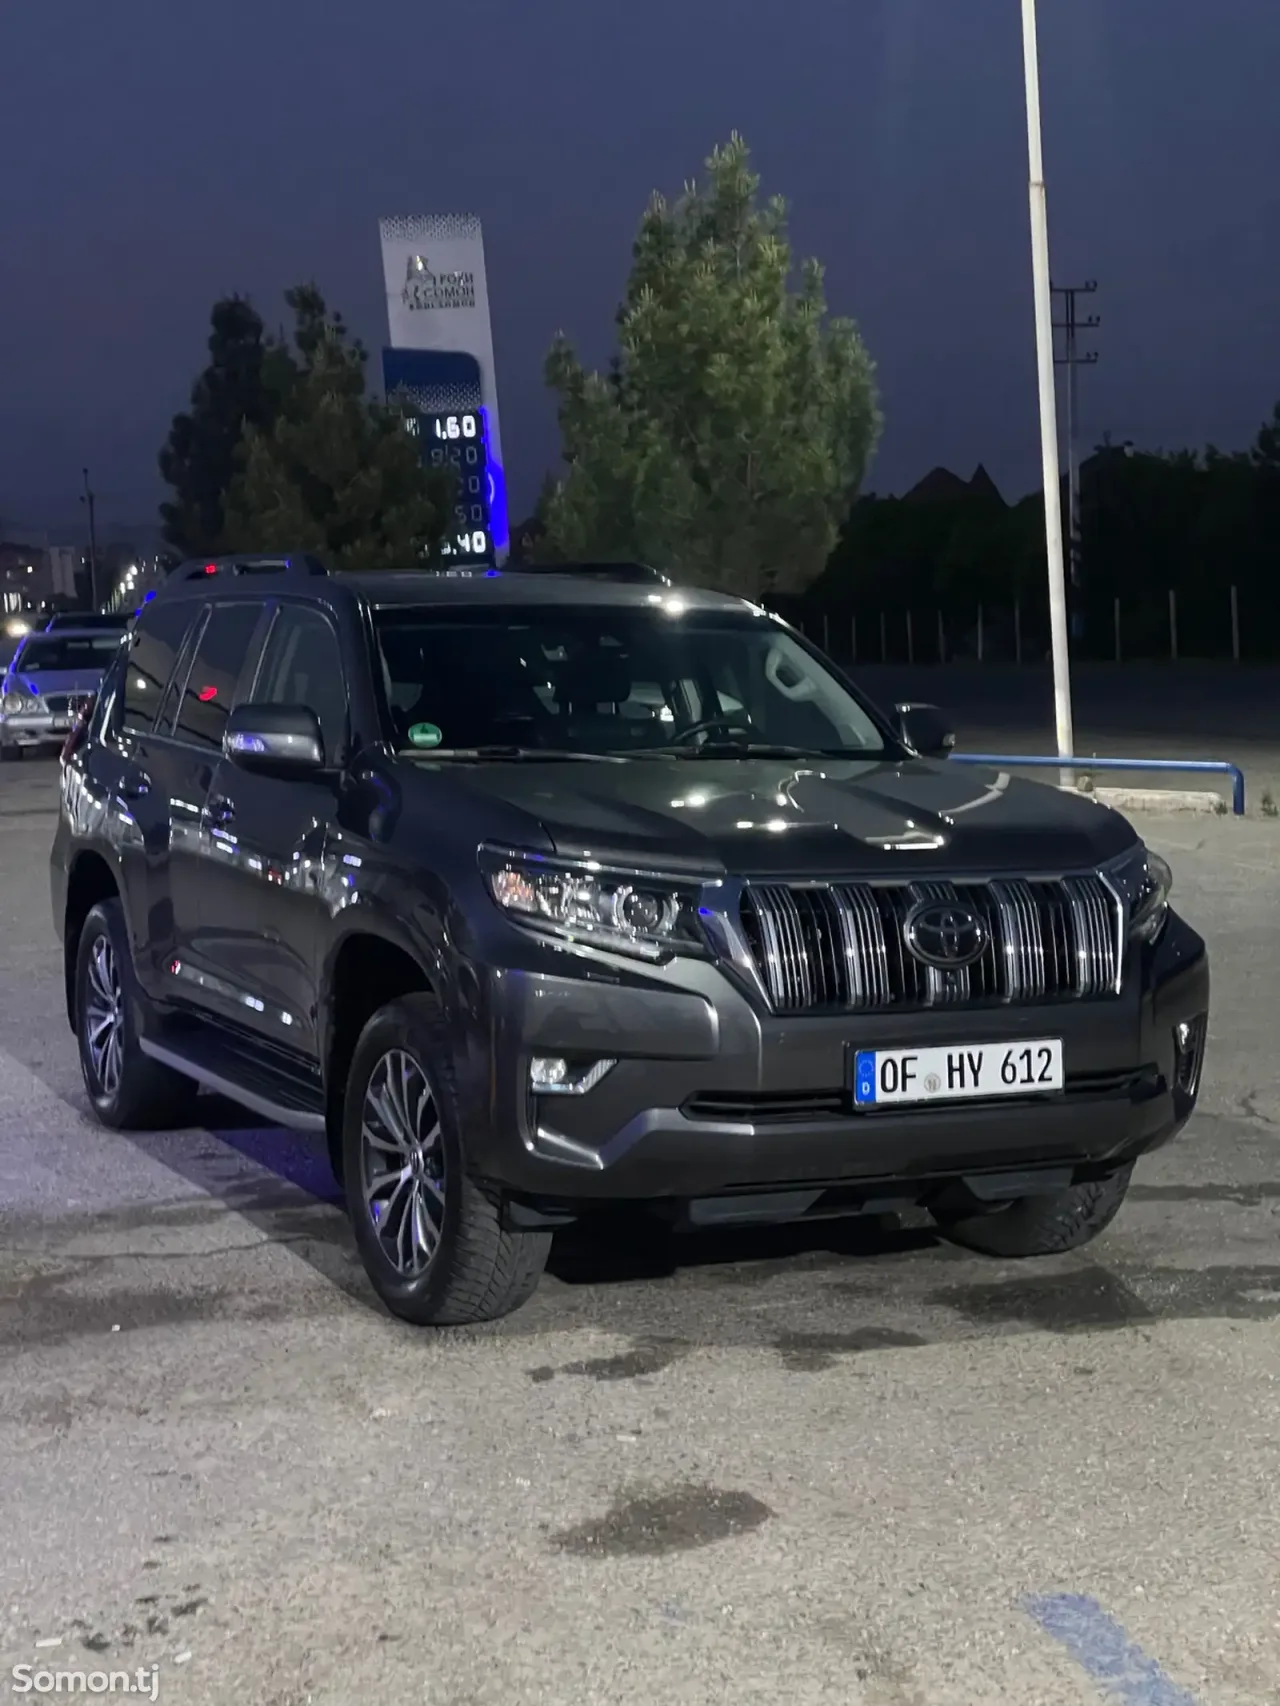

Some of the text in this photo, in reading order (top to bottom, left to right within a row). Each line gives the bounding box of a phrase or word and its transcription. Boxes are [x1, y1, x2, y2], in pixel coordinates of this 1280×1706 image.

[435, 415, 476, 440] 1.60
[880, 1047, 1053, 1093] OF HY 612
